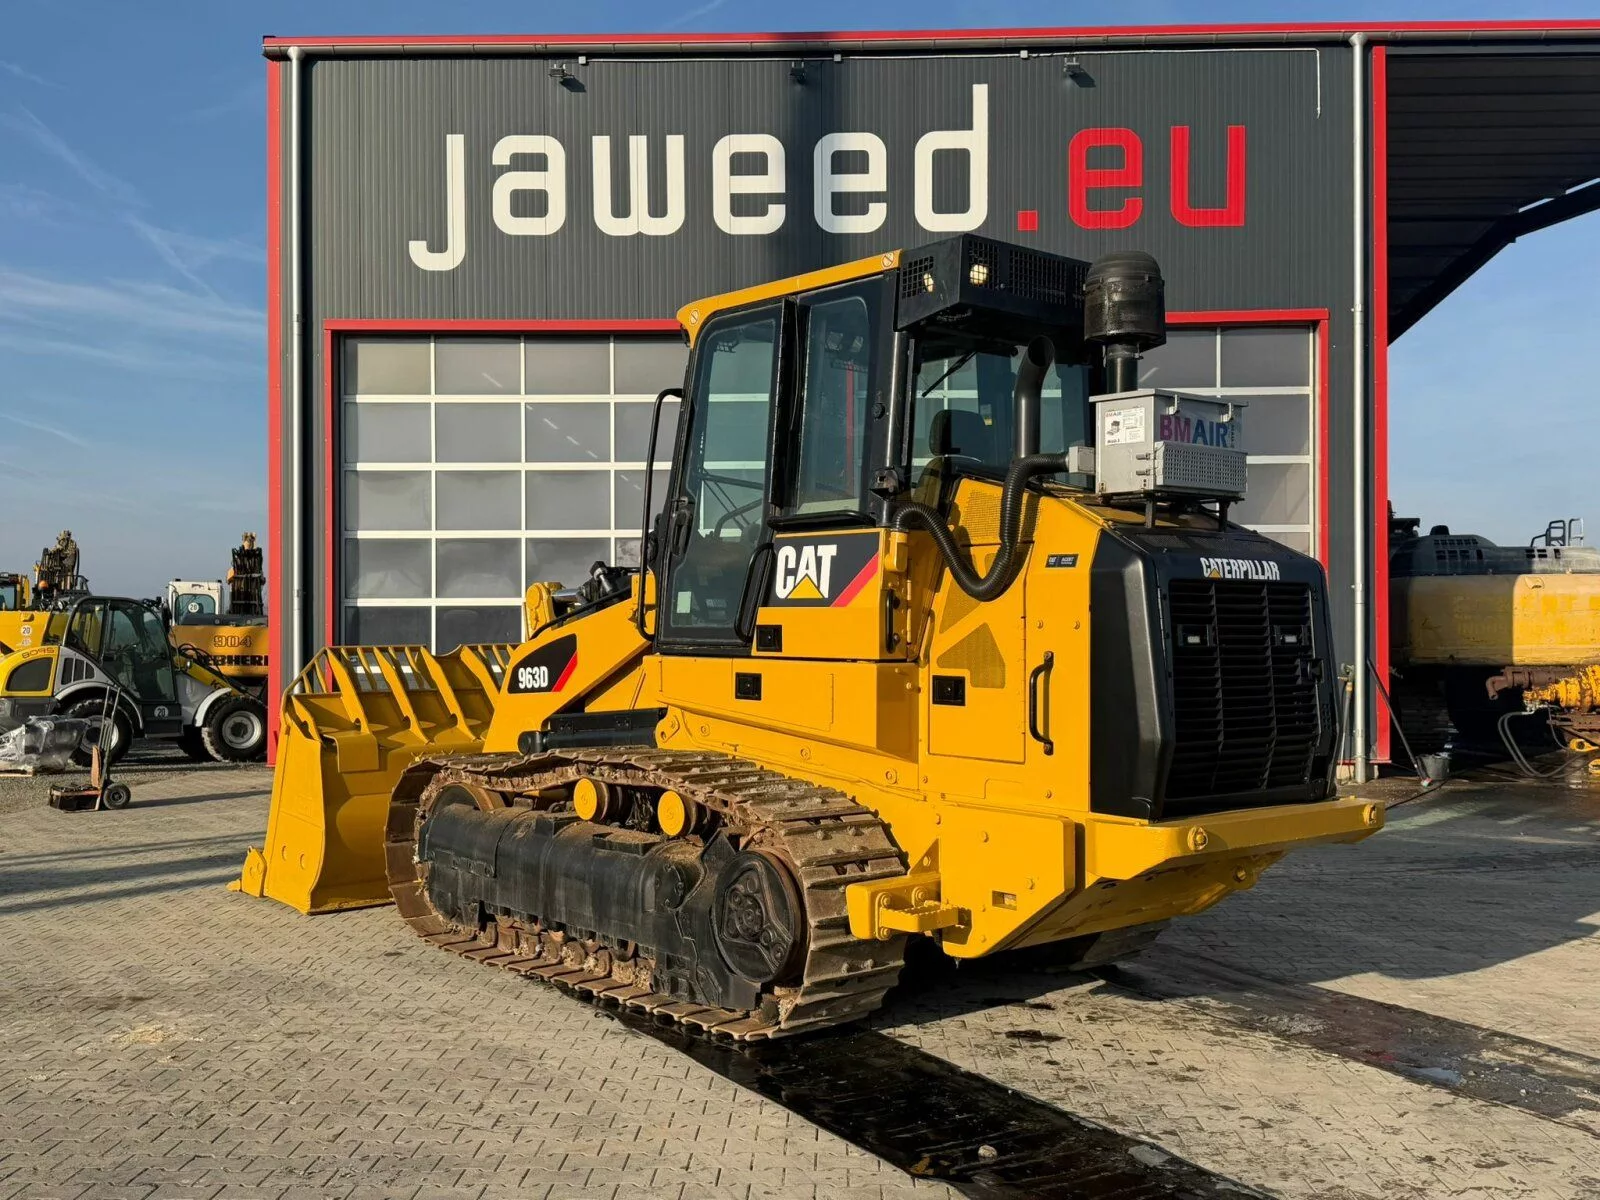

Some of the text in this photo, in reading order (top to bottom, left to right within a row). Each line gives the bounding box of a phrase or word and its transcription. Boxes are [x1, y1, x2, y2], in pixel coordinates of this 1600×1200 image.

[408, 84, 1246, 271] jaweed.eu
[1160, 414, 1229, 448] BMAIR
[775, 544, 837, 600] CAT
[1200, 557, 1280, 581] CATERPILLAR
[213, 635, 252, 648] 904
[518, 665, 548, 690] 963D
[157, 707, 166, 717] 20
